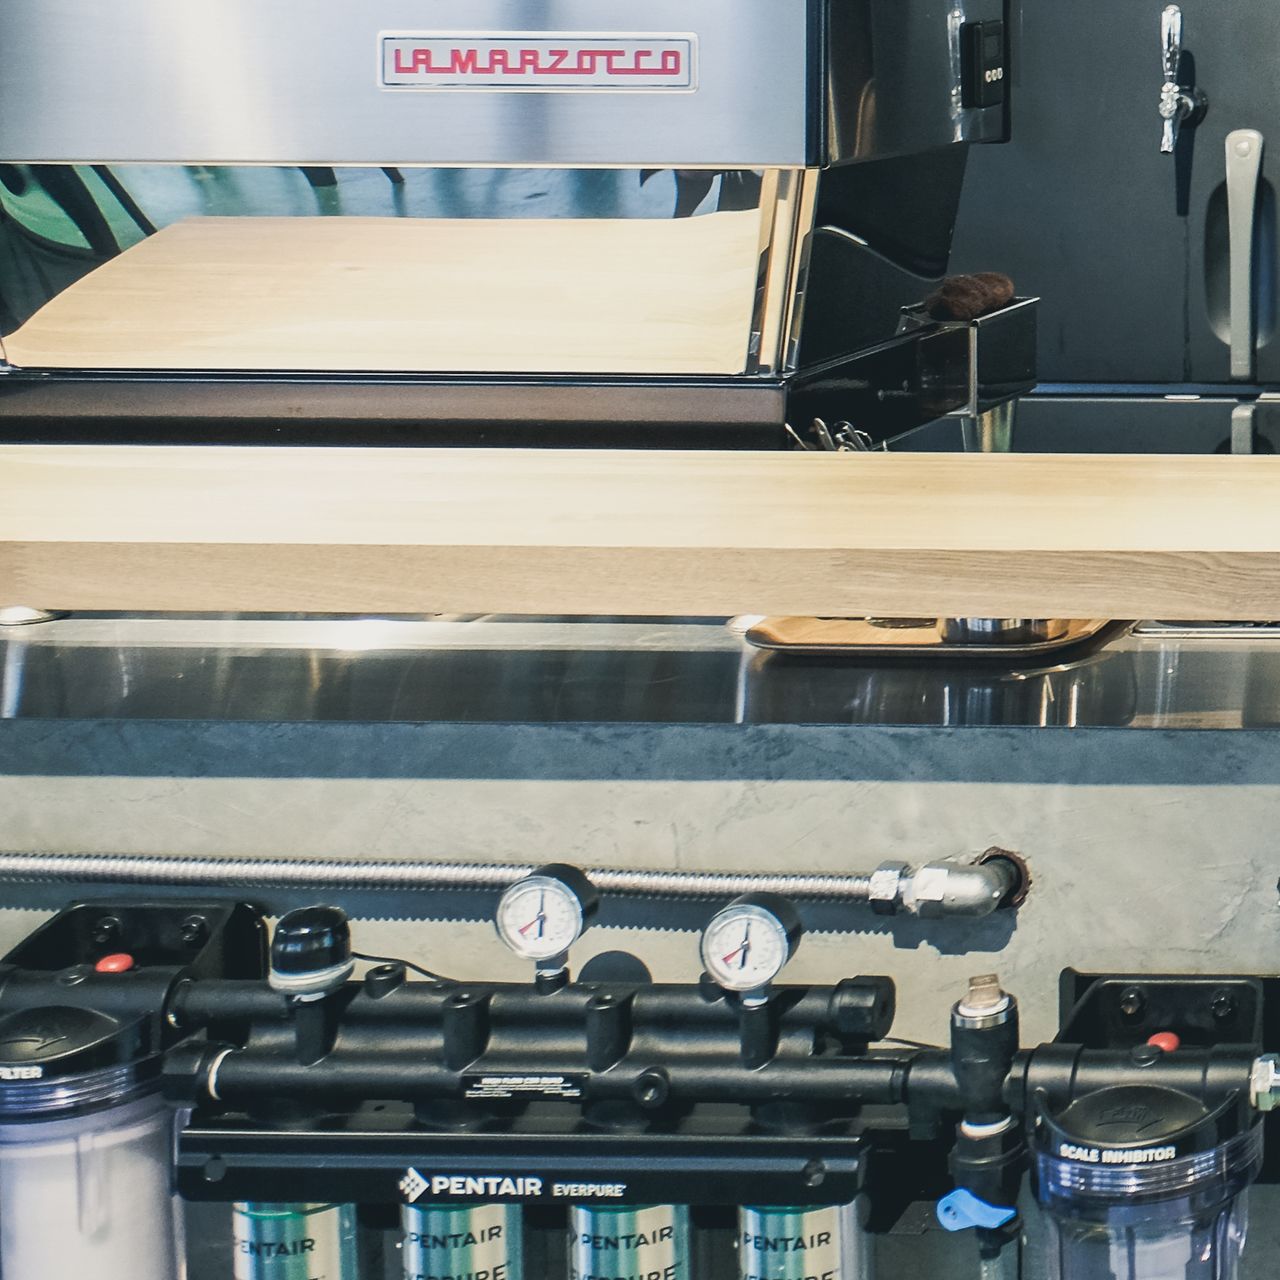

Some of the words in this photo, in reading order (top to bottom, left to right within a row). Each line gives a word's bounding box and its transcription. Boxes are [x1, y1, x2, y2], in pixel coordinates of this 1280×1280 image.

[1060, 1143, 1100, 1162] SCALE
[1102, 1145, 1176, 1164] INHIBITOR
[432, 1175, 543, 1197] PENTAIR
[552, 1183, 625, 1197] EVERPURE
[238, 1237, 316, 1257] ENTAIR
[409, 1225, 503, 1250] PENTAIR
[581, 1225, 674, 1250] PENTAIR
[743, 1231, 832, 1253] PENTAIR
